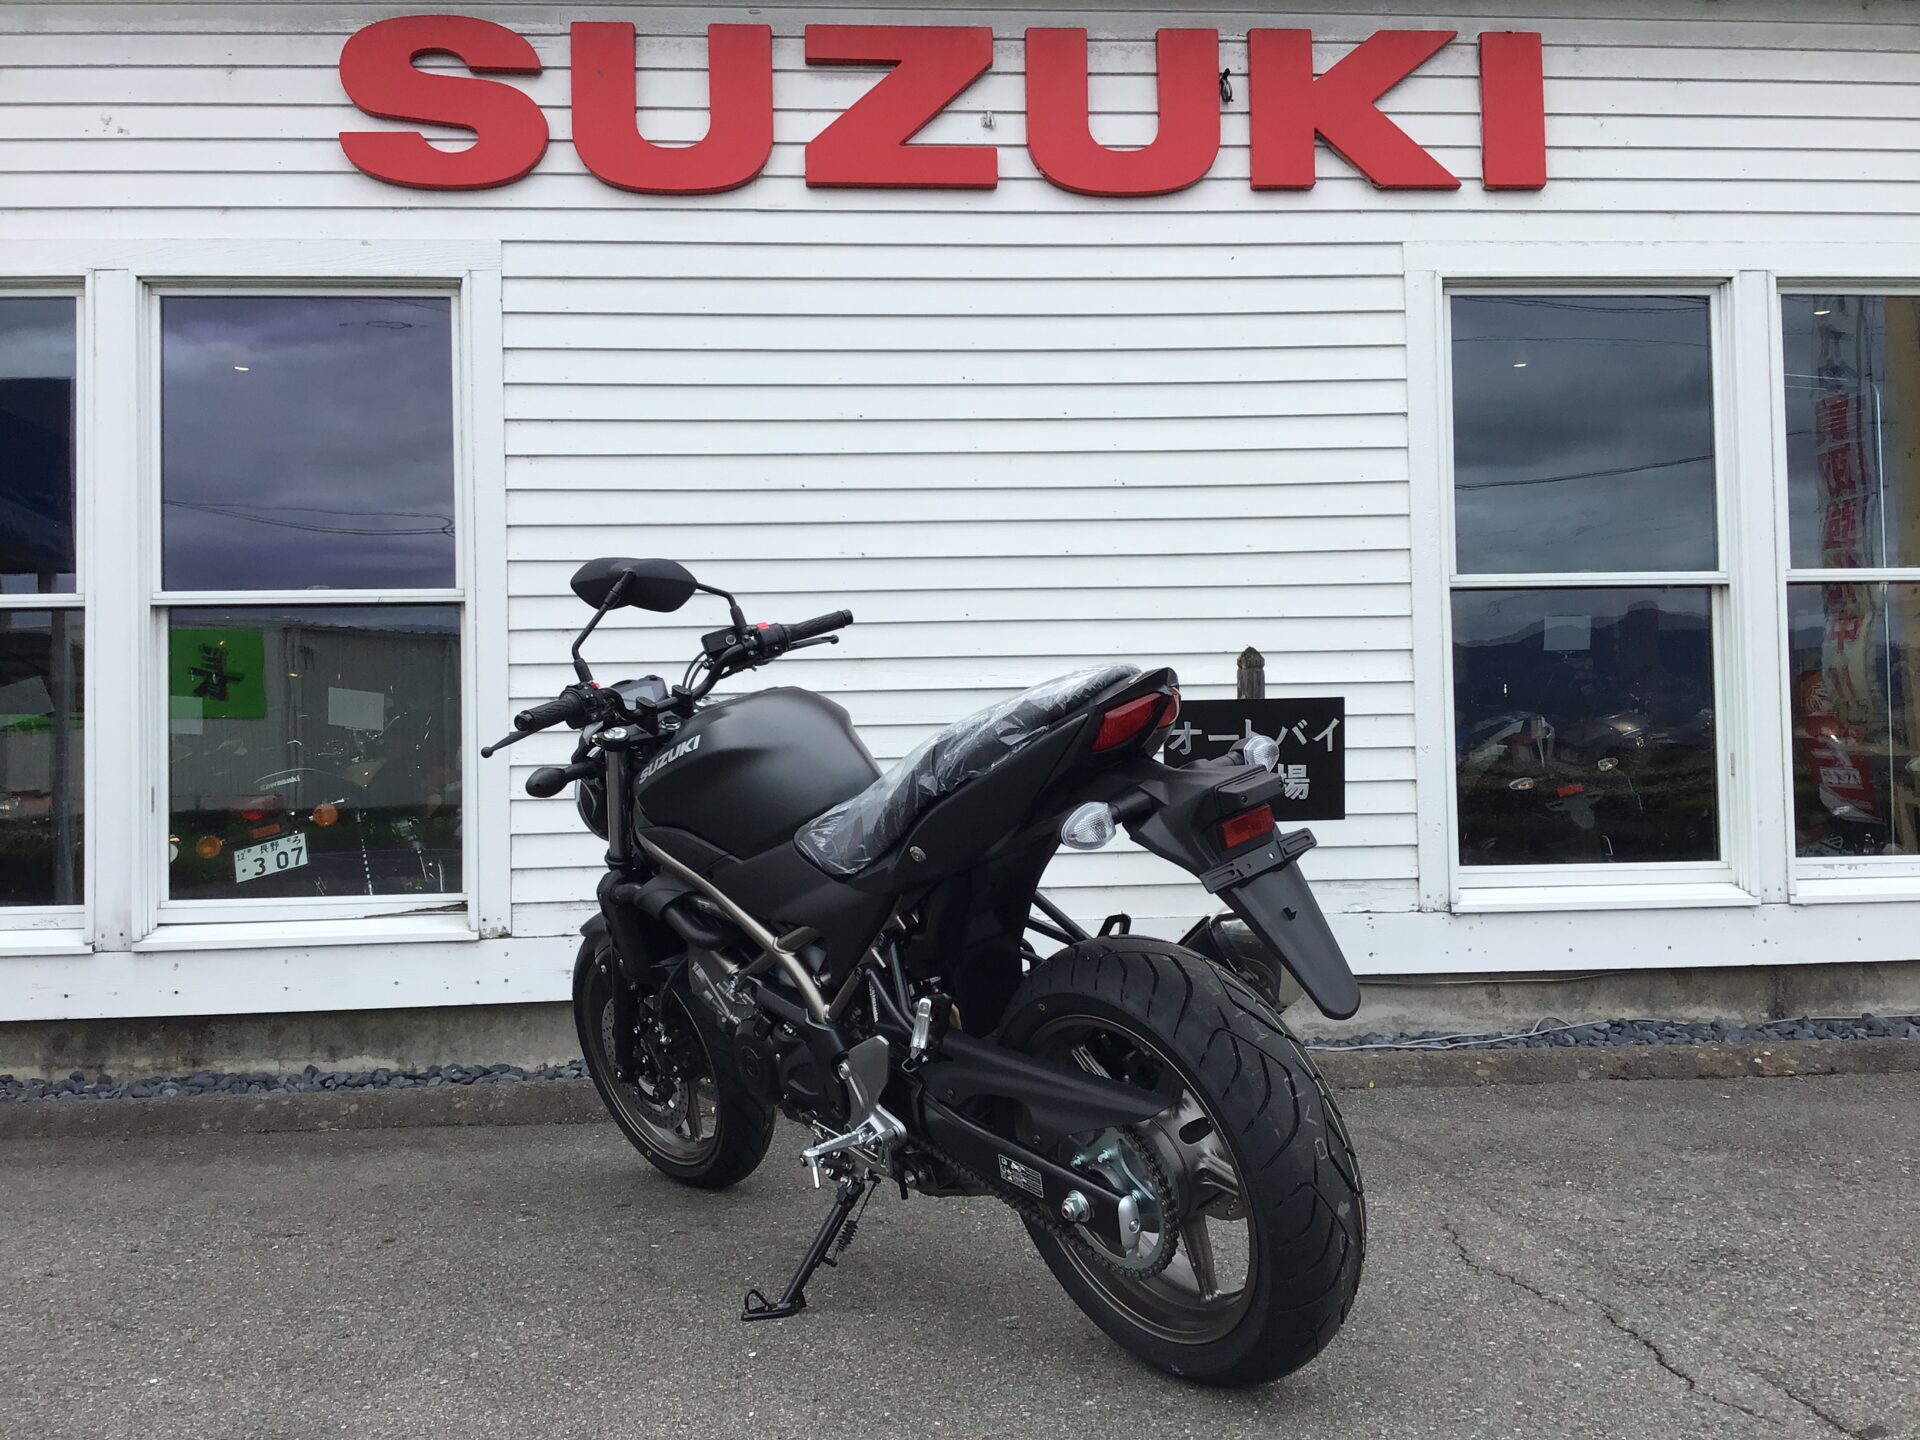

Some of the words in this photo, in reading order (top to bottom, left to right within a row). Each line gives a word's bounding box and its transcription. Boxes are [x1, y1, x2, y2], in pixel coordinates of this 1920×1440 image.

[338, 13, 1547, 197] SUZUKI
[638, 734, 701, 785] SUZUKI
[260, 841, 280, 855] 長野
